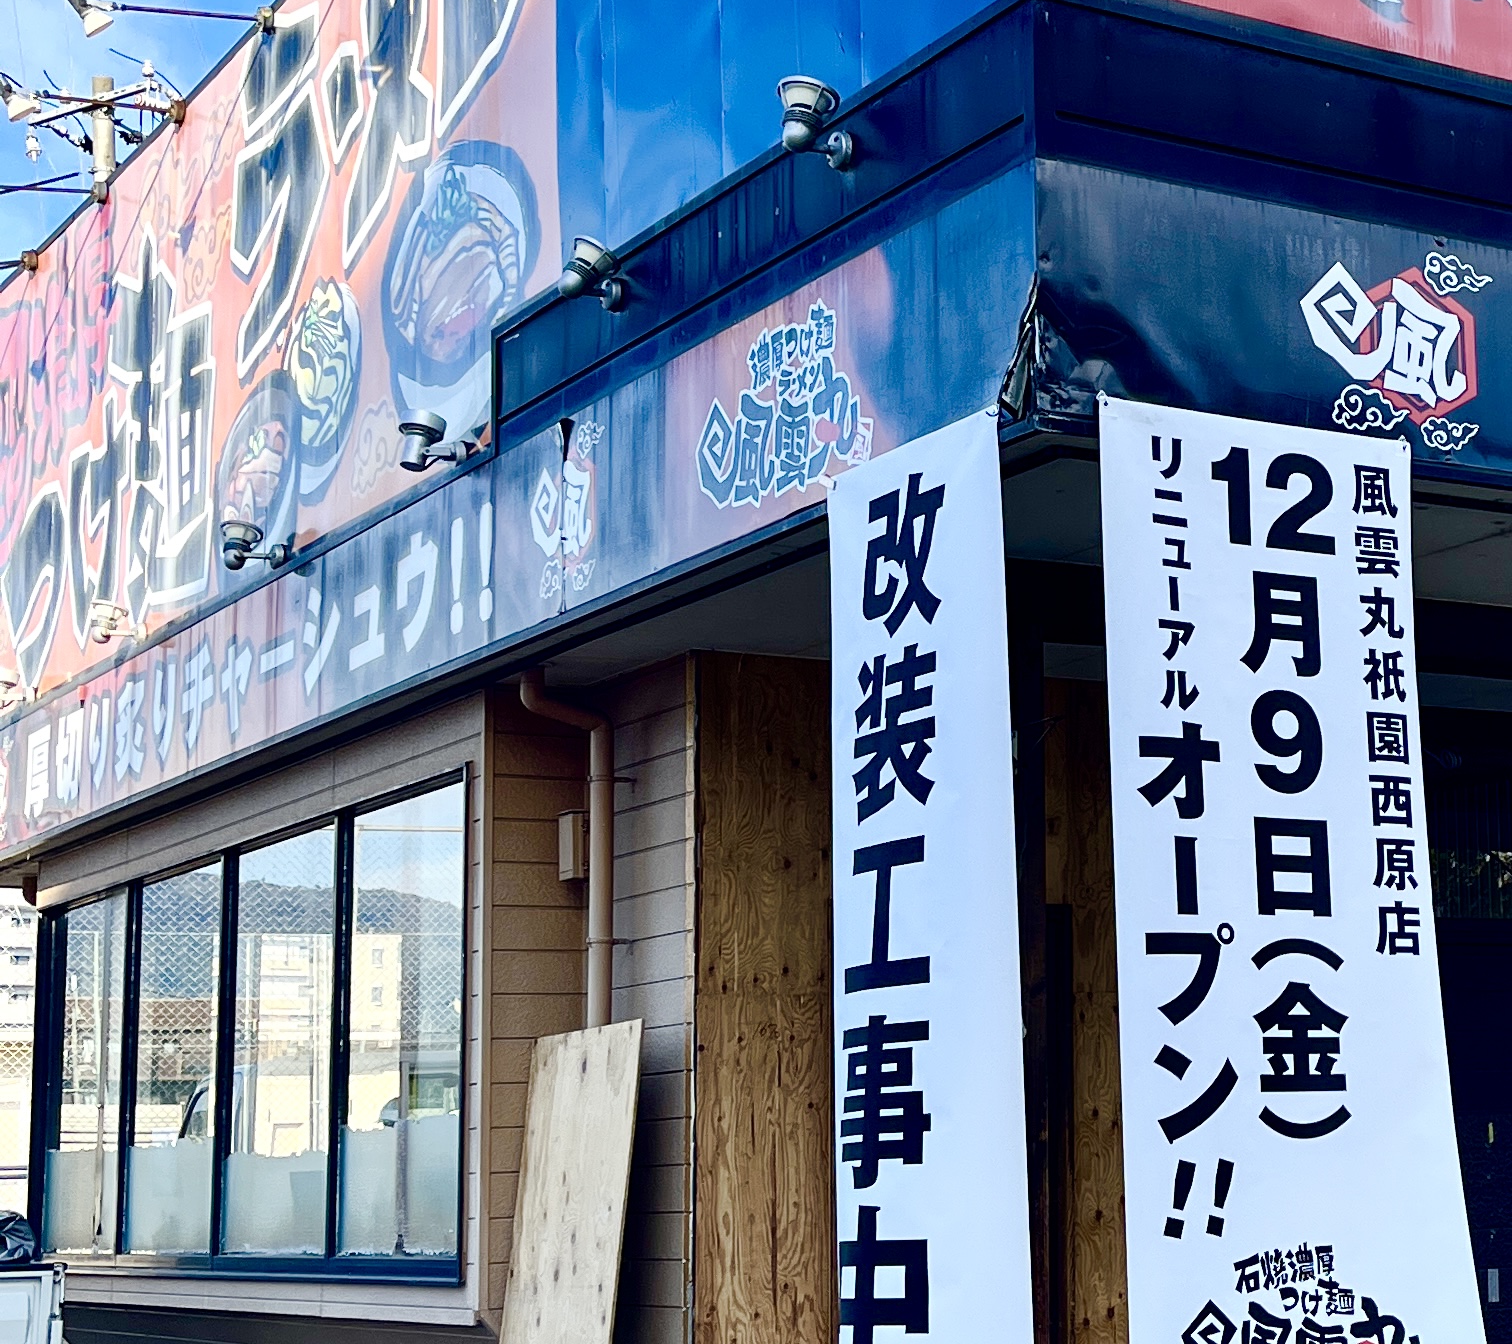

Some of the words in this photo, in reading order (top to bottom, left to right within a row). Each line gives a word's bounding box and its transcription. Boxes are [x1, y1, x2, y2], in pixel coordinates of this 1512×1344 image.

[697, 355, 859, 506] 風雲丸
[1211, 446, 1352, 1140] 12月9日(金)
[1352, 464, 1421, 955] 風雲丸祇園西原店
[1279, 1276, 1355, 1317] つけ麺
